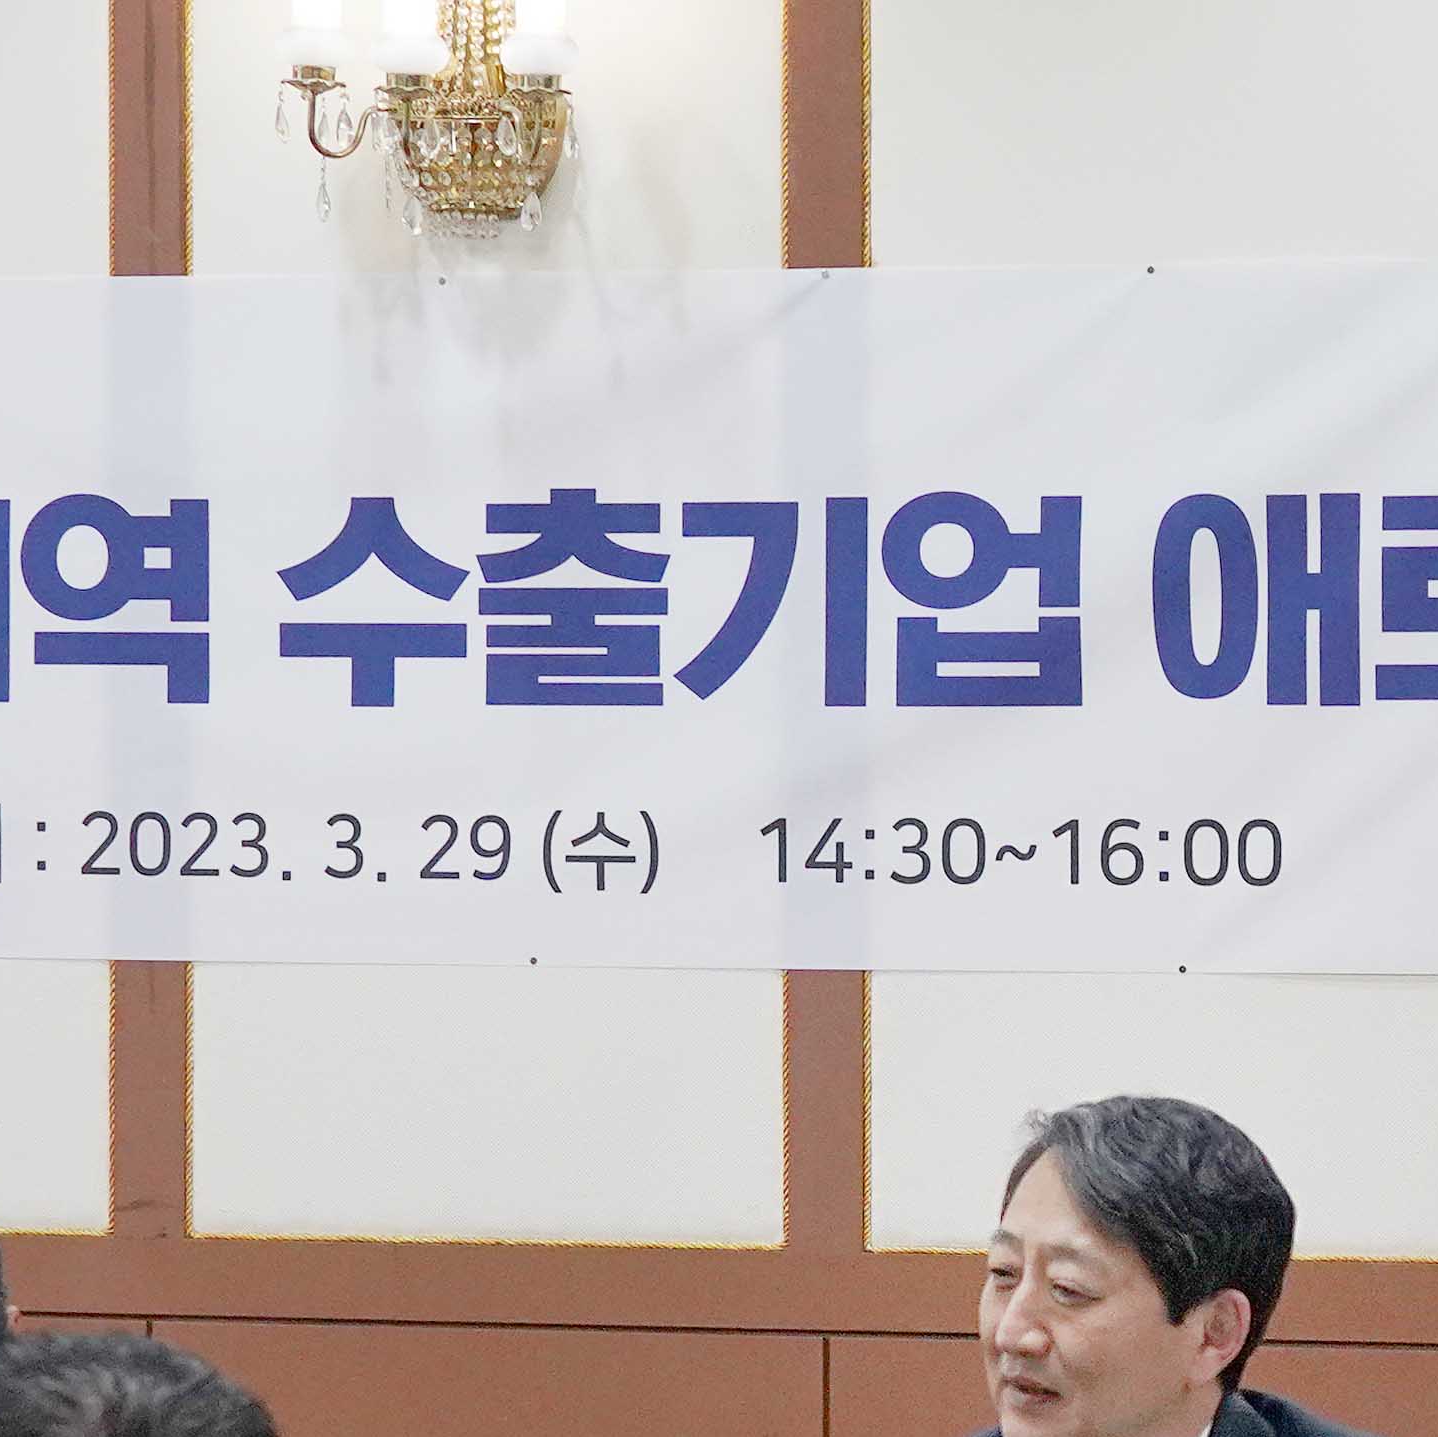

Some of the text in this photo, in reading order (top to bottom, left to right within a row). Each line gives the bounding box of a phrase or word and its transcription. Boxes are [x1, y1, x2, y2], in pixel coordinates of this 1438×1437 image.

[276, 487, 1084, 708] 수출기업
[79, 810, 293, 882] 2023.
[324, 813, 388, 883] 3.
[418, 814, 512, 881] 29
[542, 809, 660, 894] (수)
[759, 817, 1283, 887] 14:30~16:00
